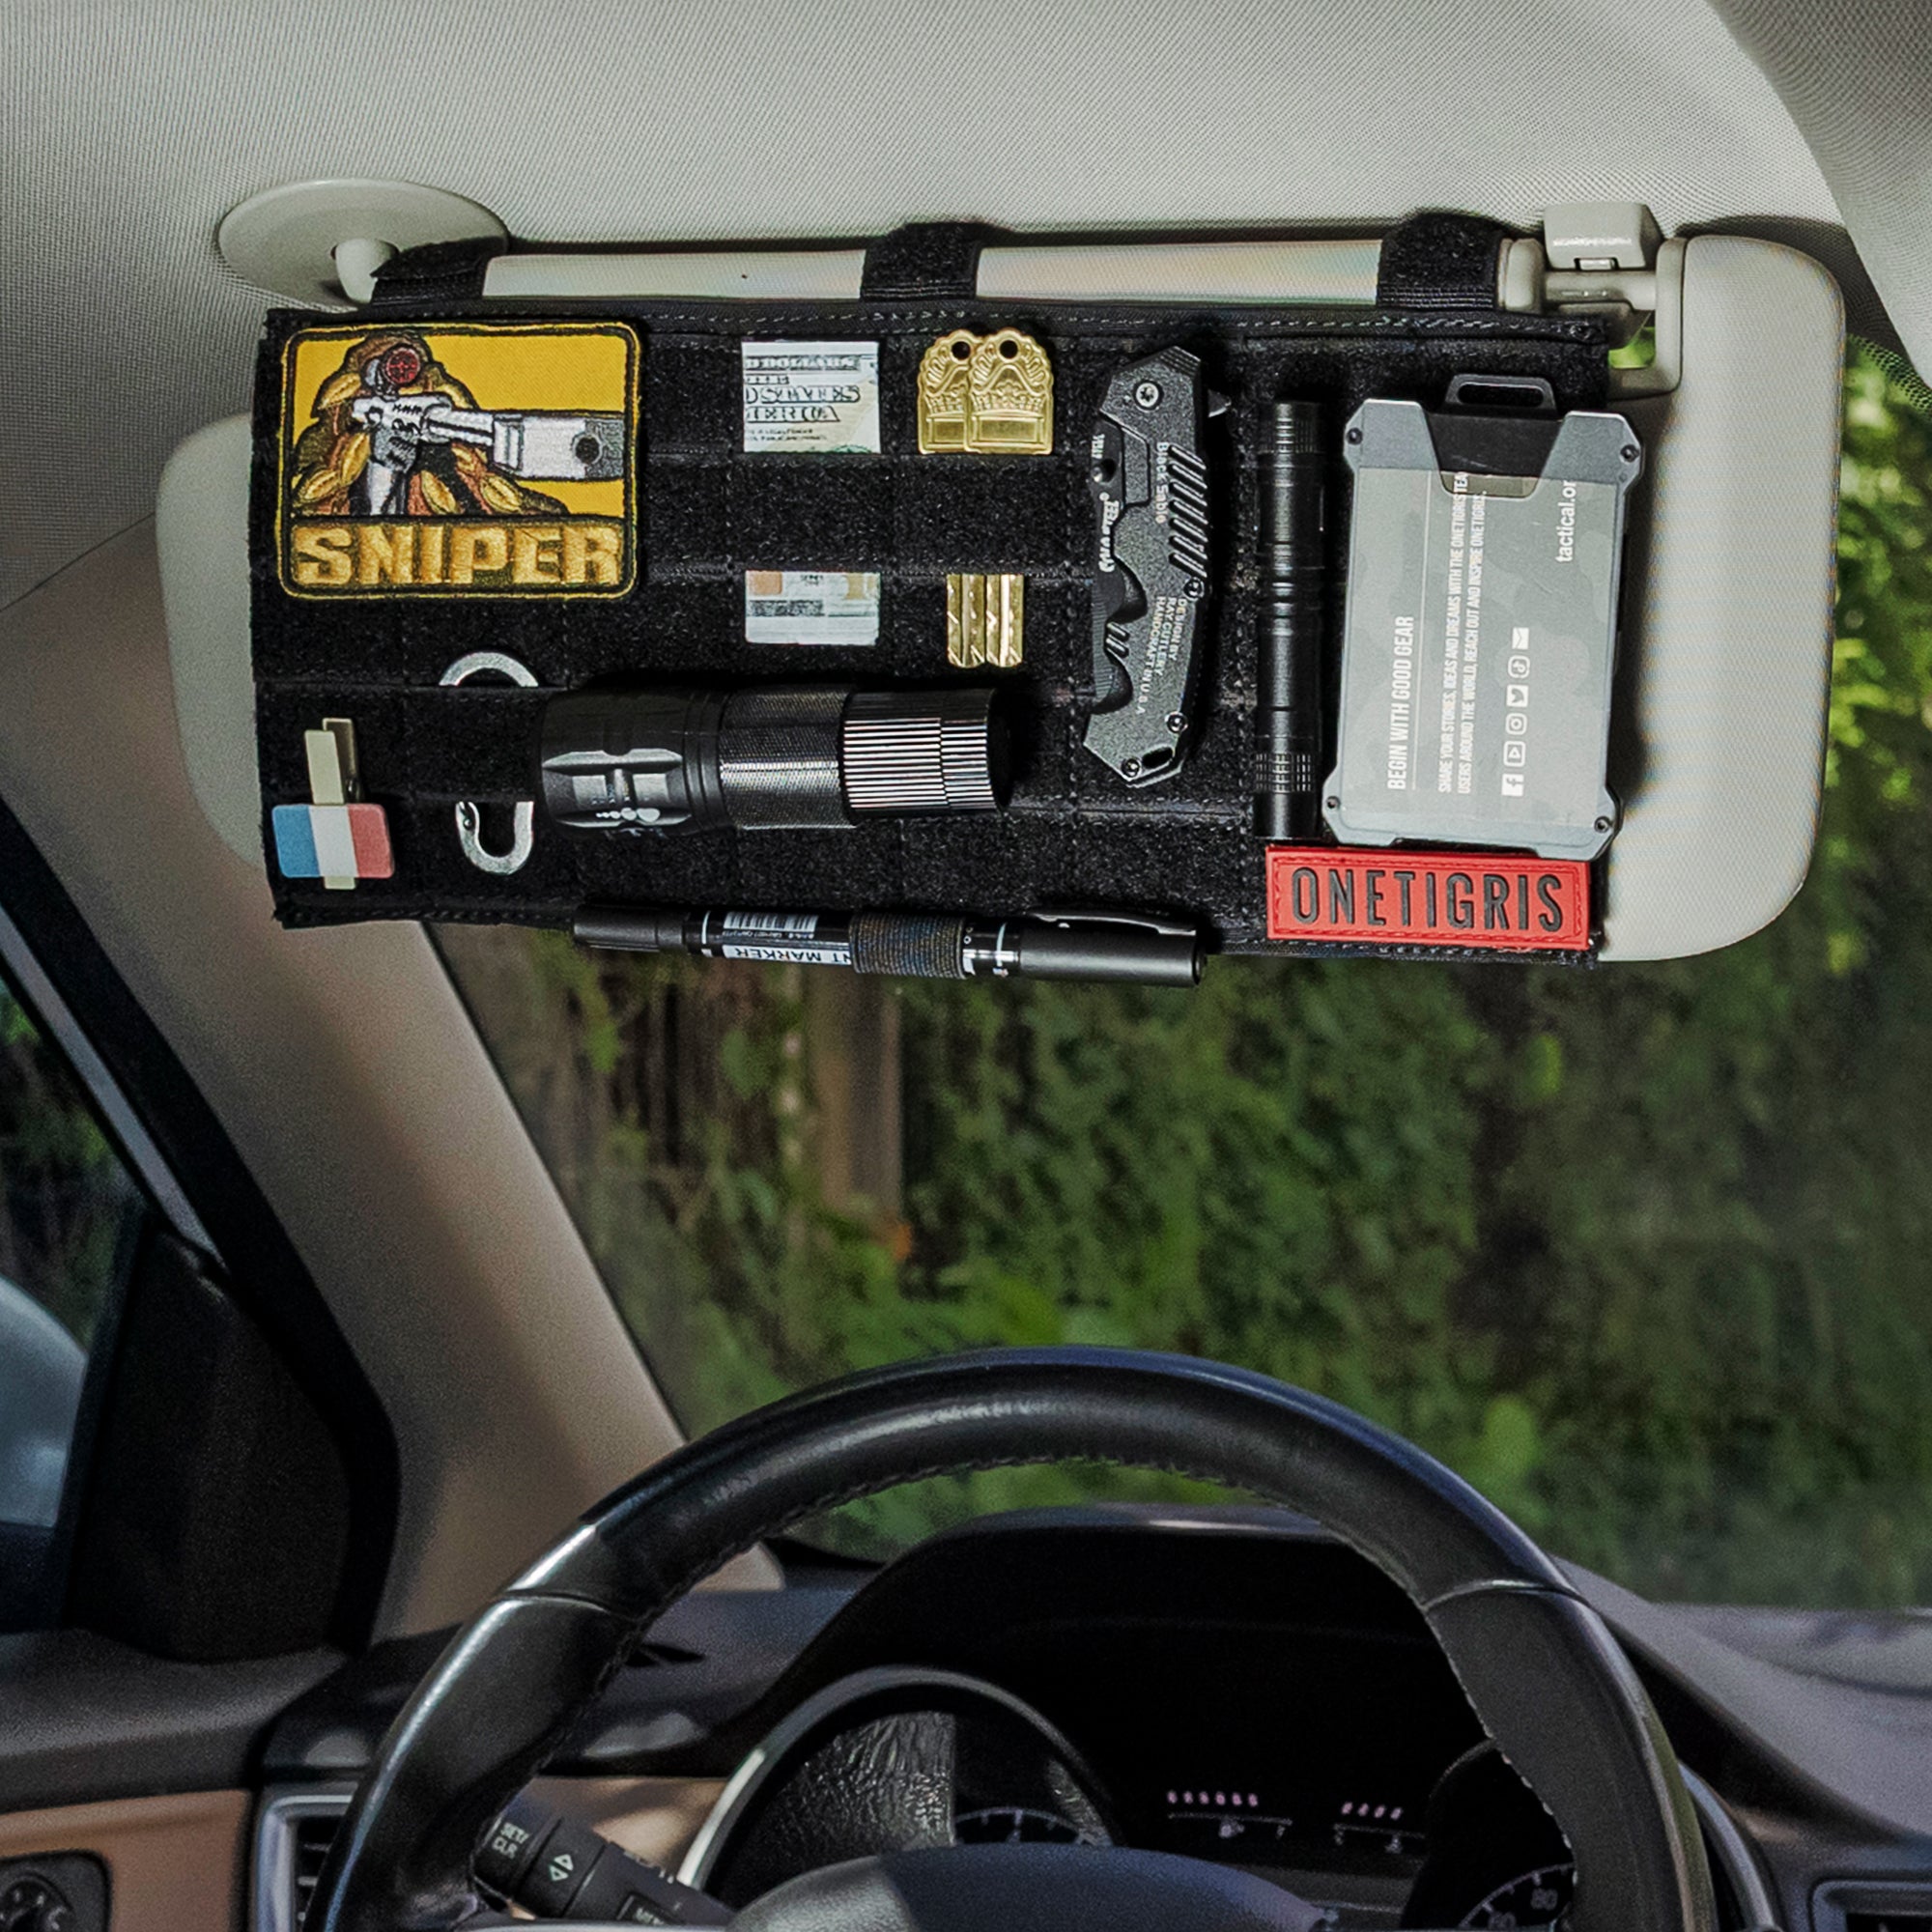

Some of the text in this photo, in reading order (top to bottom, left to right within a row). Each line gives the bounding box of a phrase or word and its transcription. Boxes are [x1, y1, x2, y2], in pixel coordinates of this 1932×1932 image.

[760, 386, 862, 404] STATES
[746, 406, 840, 423] ERICA
[1451, 494, 1466, 548] ONETIGRIS
[293, 526, 623, 585] SNIPER
[1450, 549, 1464, 568] THE
[1467, 548, 1484, 584] INSPIRE
[1448, 569, 1463, 595] WITH
[1466, 587, 1482, 610] AND
[1145, 595, 1167, 668] HANDCRAFT
[1168, 598, 1188, 662] DESIGN BY
[1446, 596, 1462, 638] DREAMS
[1465, 610, 1481, 629] OUT
[1154, 596, 1178, 676] RAY CUTLERY
[1444, 639, 1460, 660] AND
[1463, 630, 1479, 662] REACH
[1443, 660, 1458, 689] IDEAS
[1387, 615, 1414, 790] BEGIN WITH GOOD GEAR
[1461, 701, 1476, 721] THE
[1439, 731, 1455, 759] YOUR
[1459, 722, 1474, 762] AROUND
[1437, 757, 1453, 793] SHARE
[1457, 762, 1472, 794] USERS
[1291, 867, 1564, 933] ONETIGRIS
[735, 947, 822, 962] MARKER
